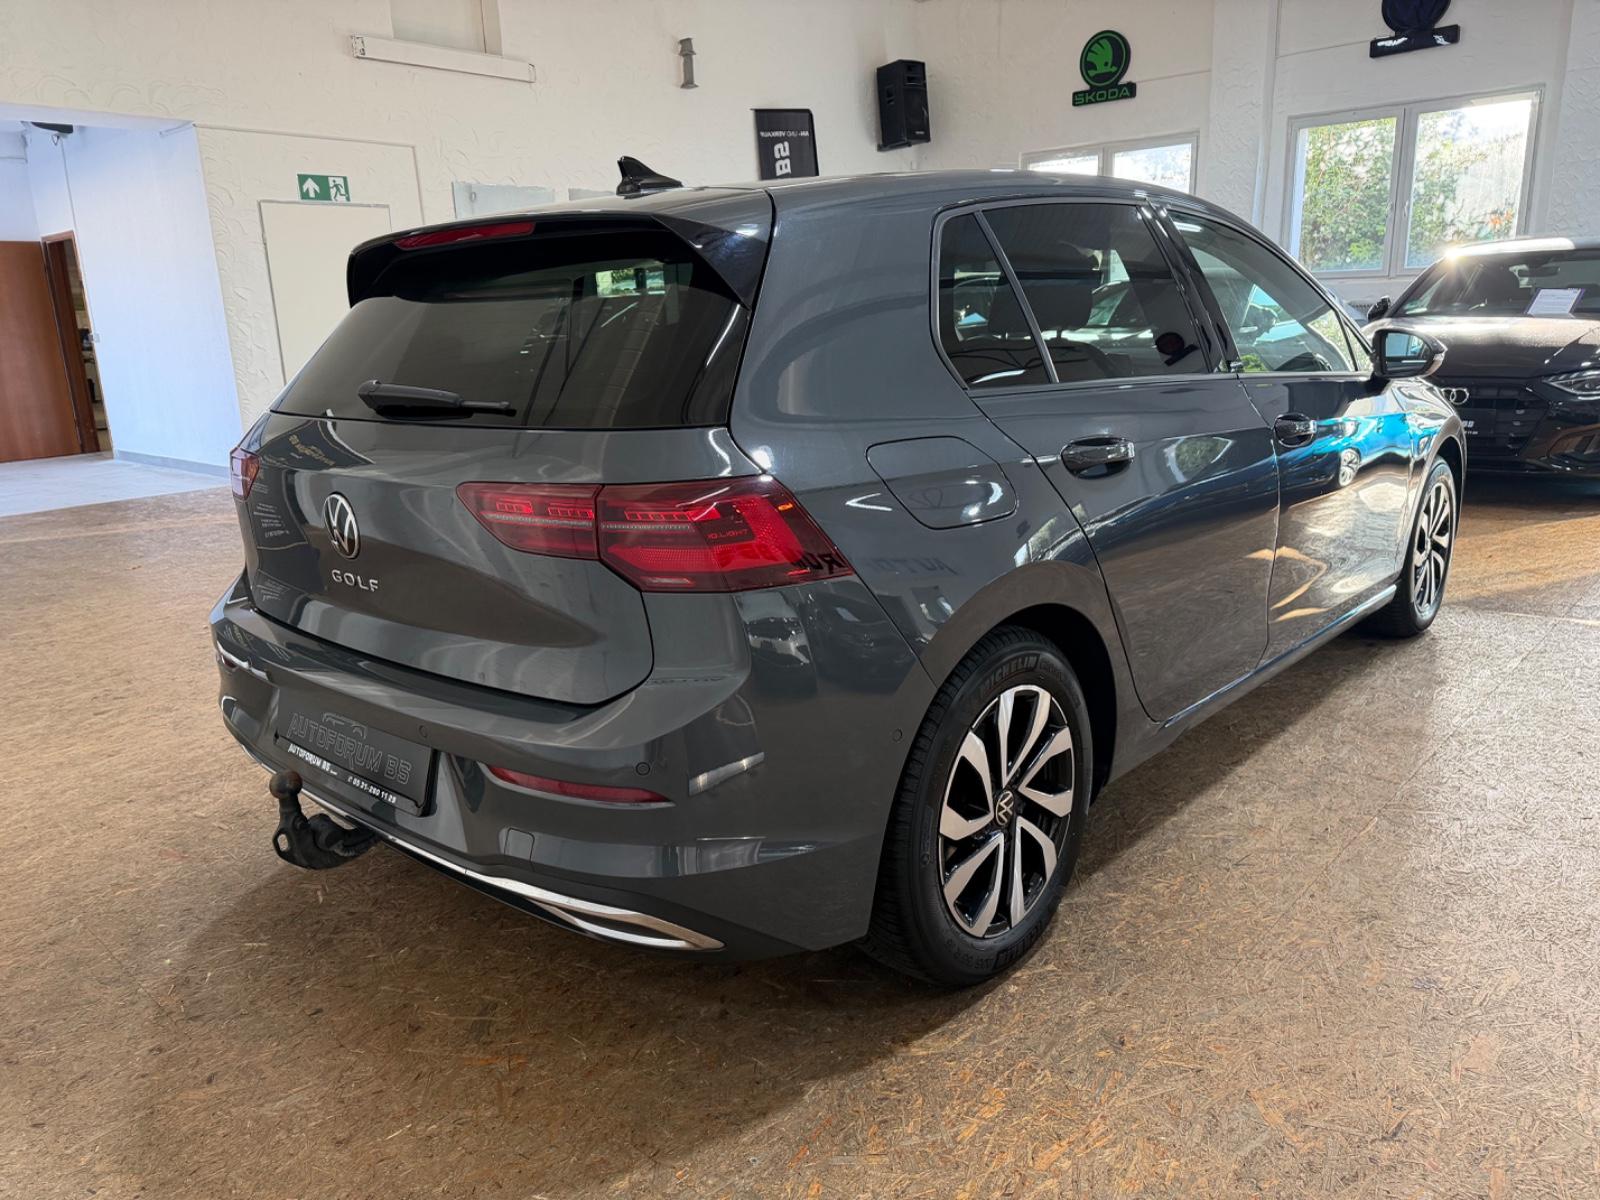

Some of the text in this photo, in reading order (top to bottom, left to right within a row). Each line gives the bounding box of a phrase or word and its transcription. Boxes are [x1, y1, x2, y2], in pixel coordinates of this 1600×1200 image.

[331, 569, 378, 592] GOLF
[287, 713, 412, 784] AUTOFORUM BS
[287, 743, 321, 767] AUTOFORUM
